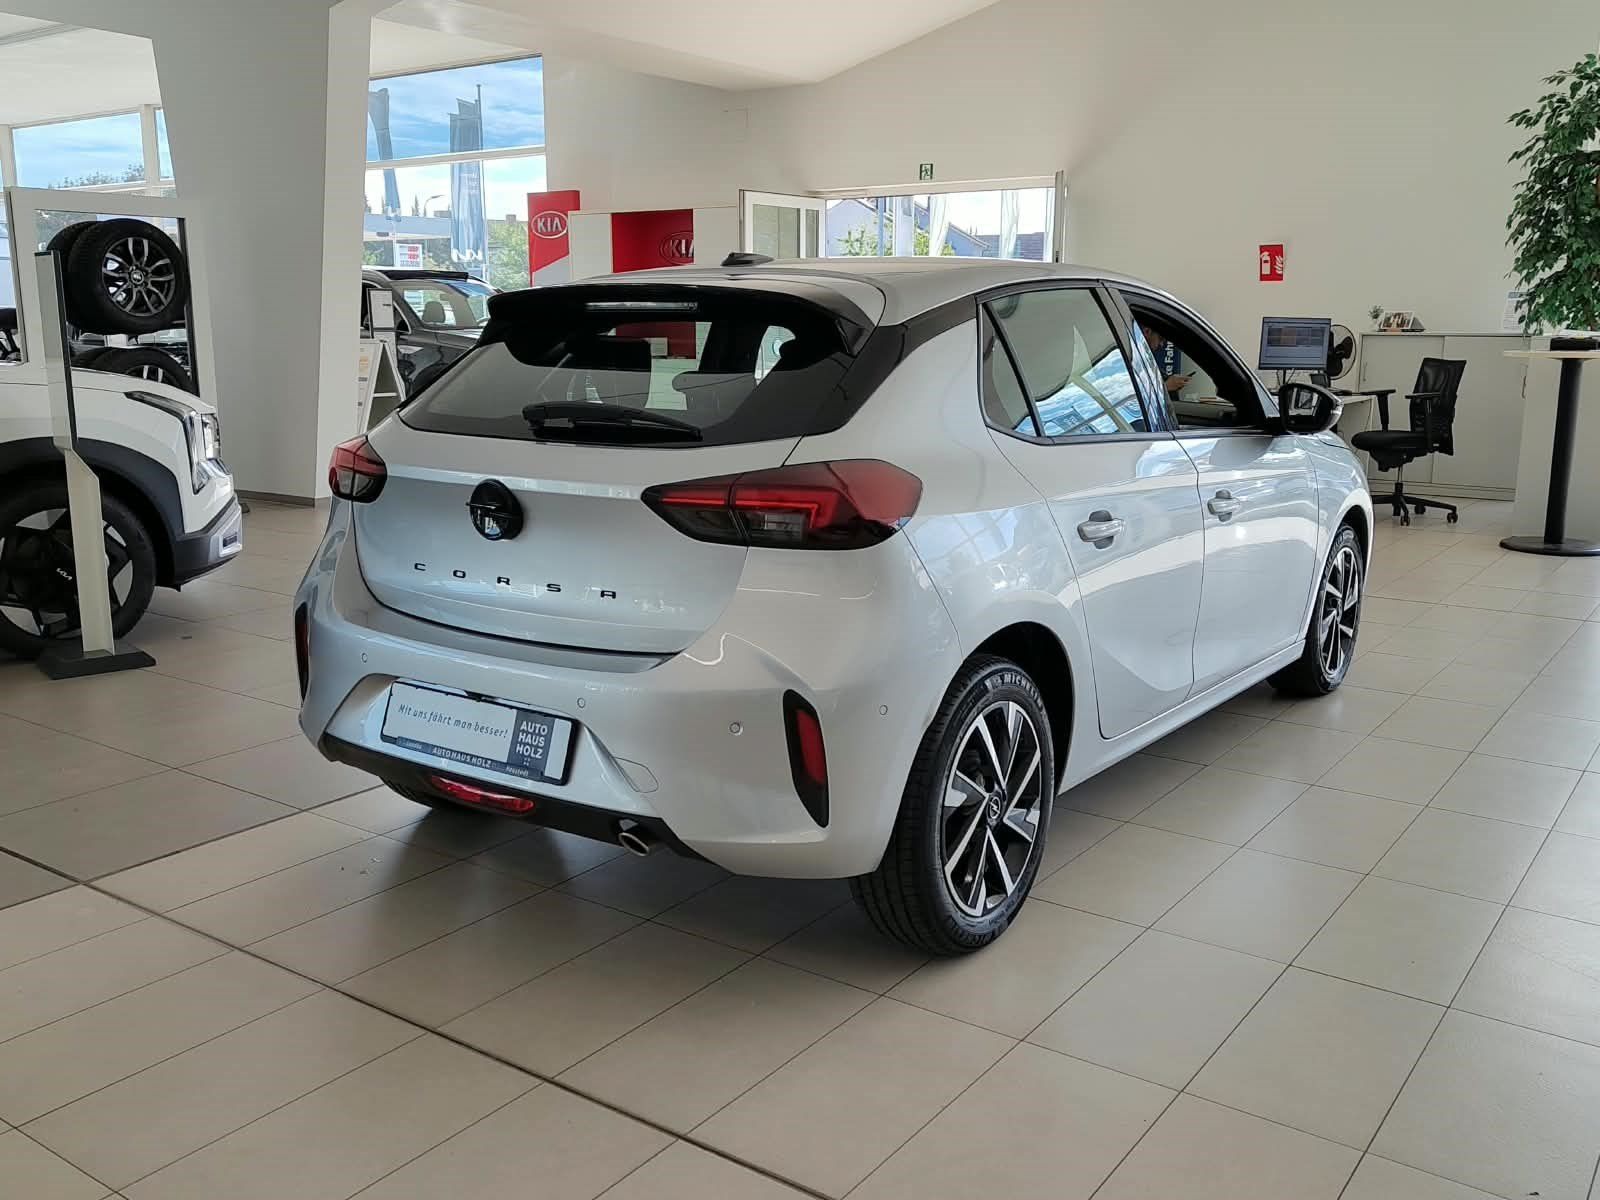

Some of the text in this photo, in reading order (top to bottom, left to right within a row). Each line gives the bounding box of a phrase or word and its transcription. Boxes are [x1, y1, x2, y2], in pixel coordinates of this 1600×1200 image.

[537, 217, 562, 233] KIA
[414, 562, 617, 600] CORSA
[398, 703, 508, 738] Mit uns fährt man besser!
[520, 720, 548, 736] AUTO
[518, 732, 546, 747] HAUS
[515, 743, 543, 759] HOLZ
[471, 756, 492, 768] HOLZ
